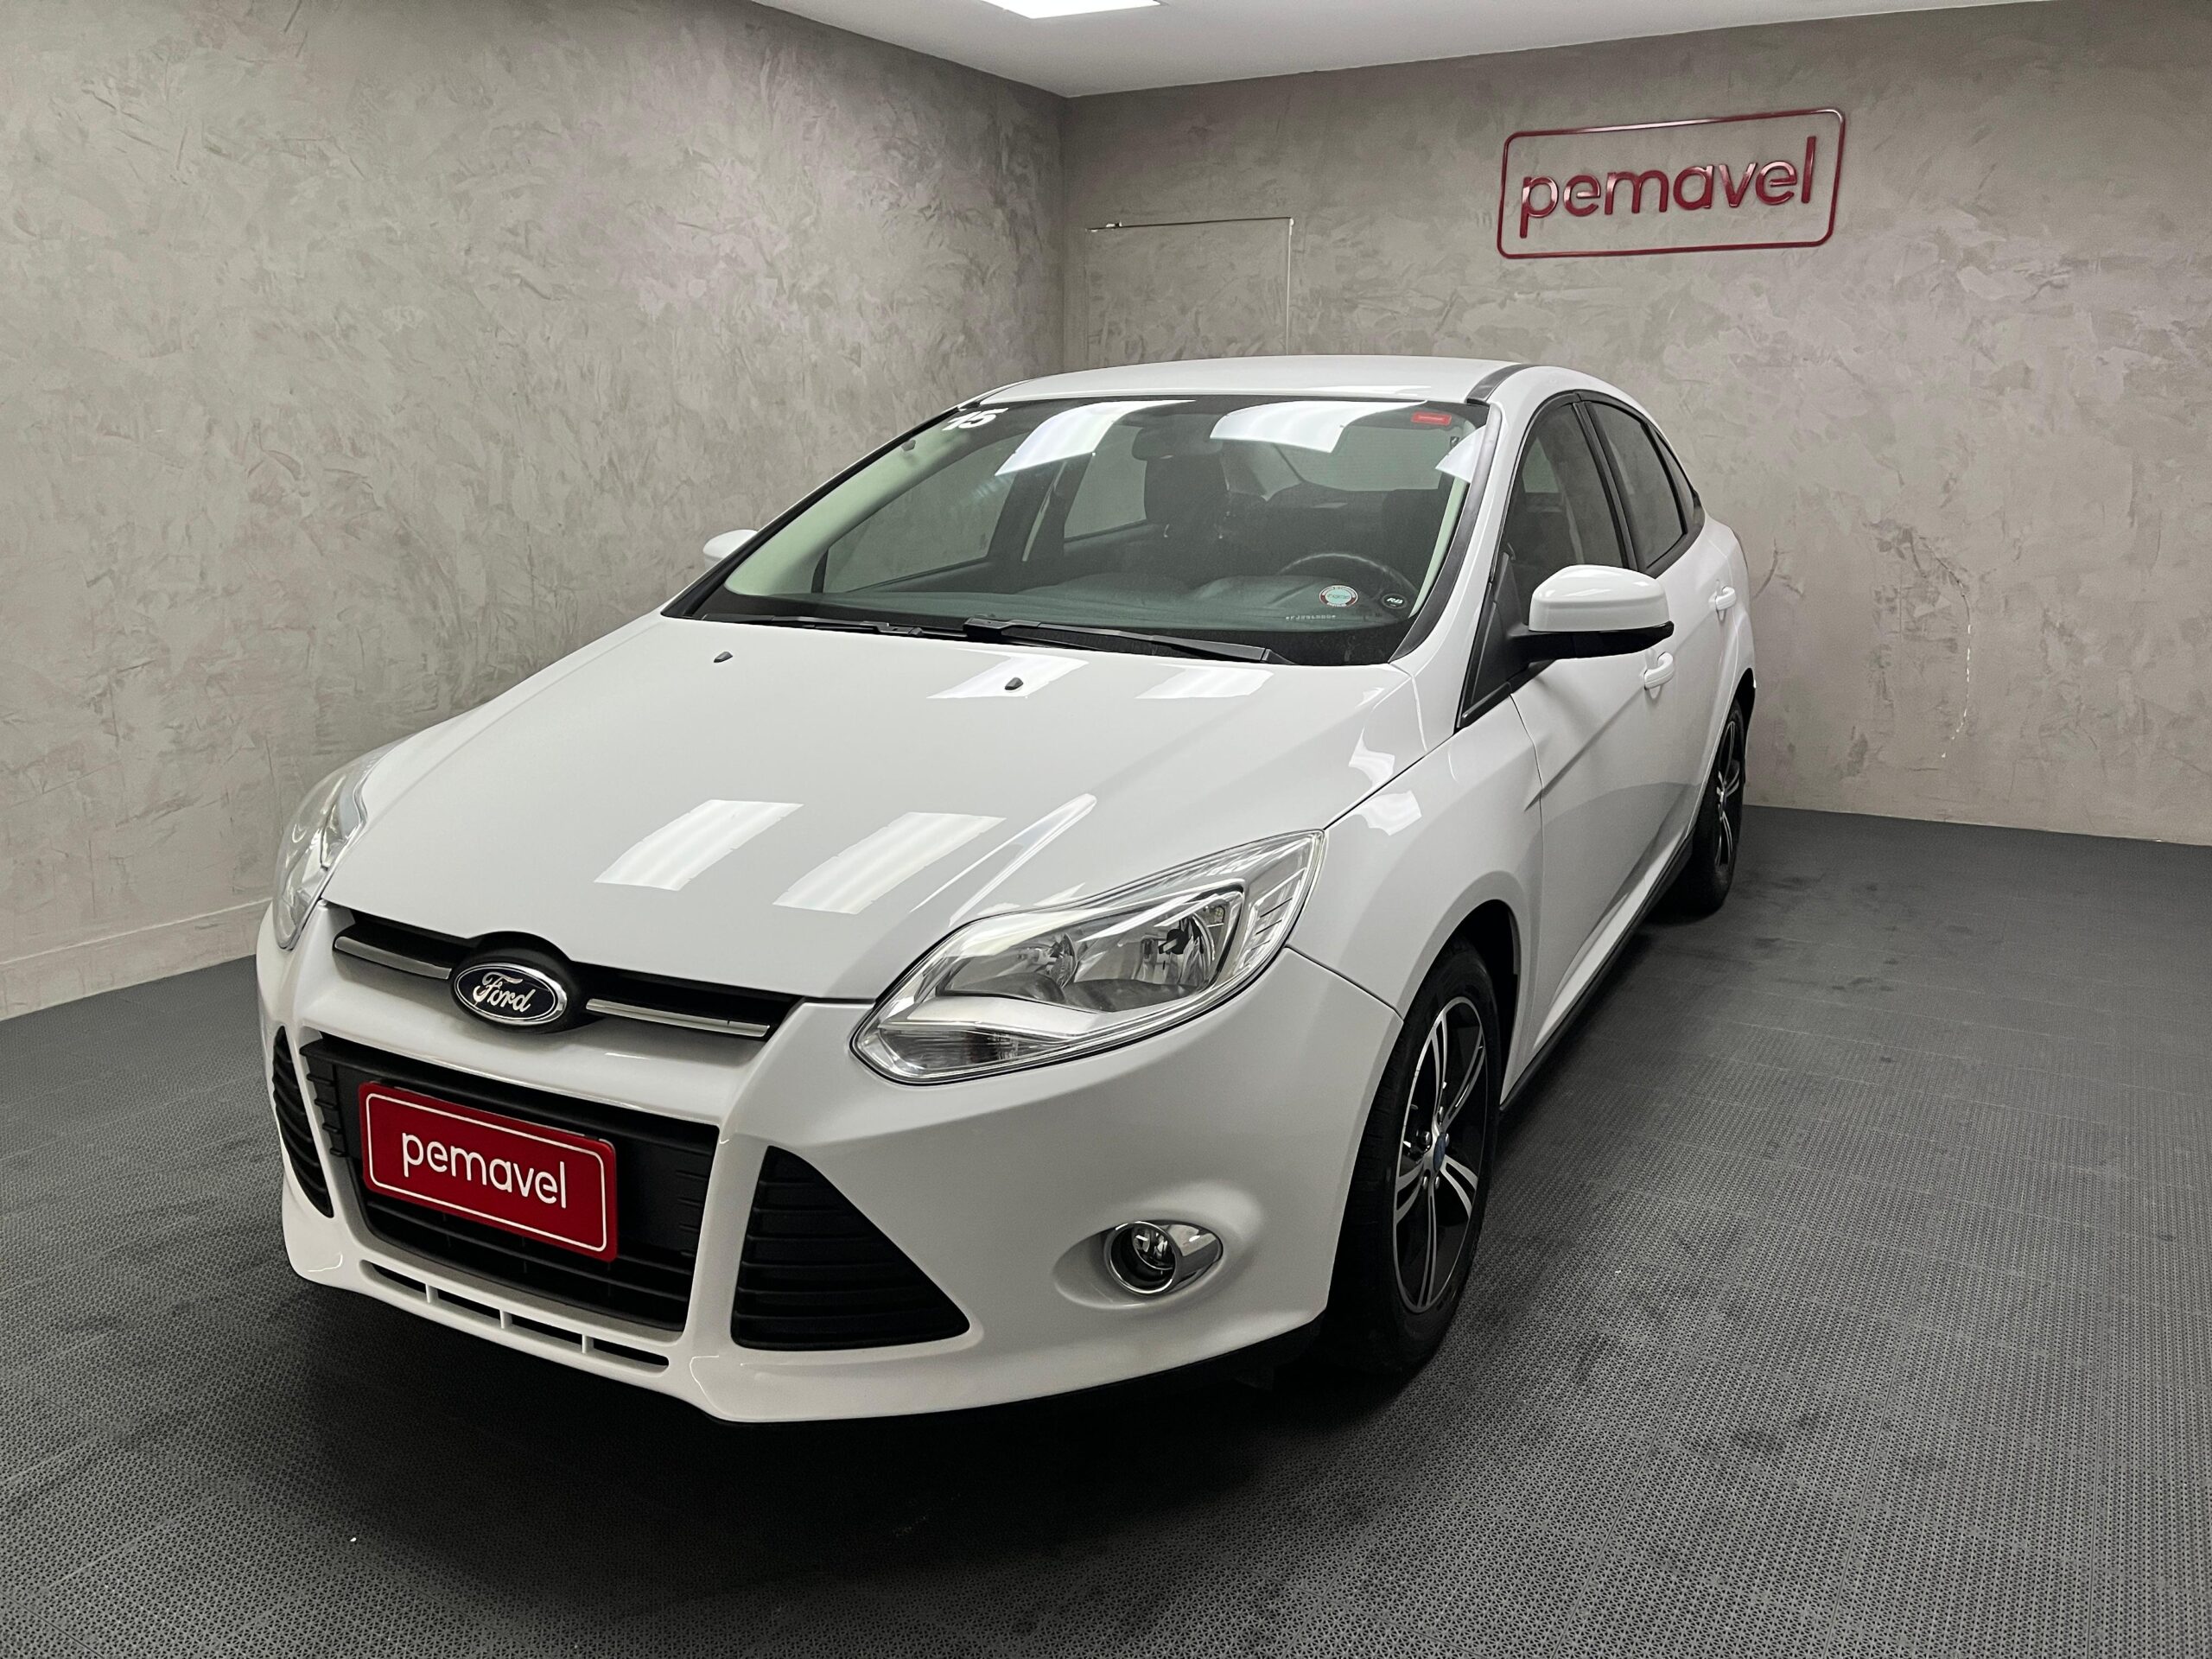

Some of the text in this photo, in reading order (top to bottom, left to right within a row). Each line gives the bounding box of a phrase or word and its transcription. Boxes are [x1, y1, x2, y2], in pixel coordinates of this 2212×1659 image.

[1519, 136, 1817, 238] pemavel
[473, 971, 537, 1013] Ford
[402, 1132, 567, 1209] pemavel
